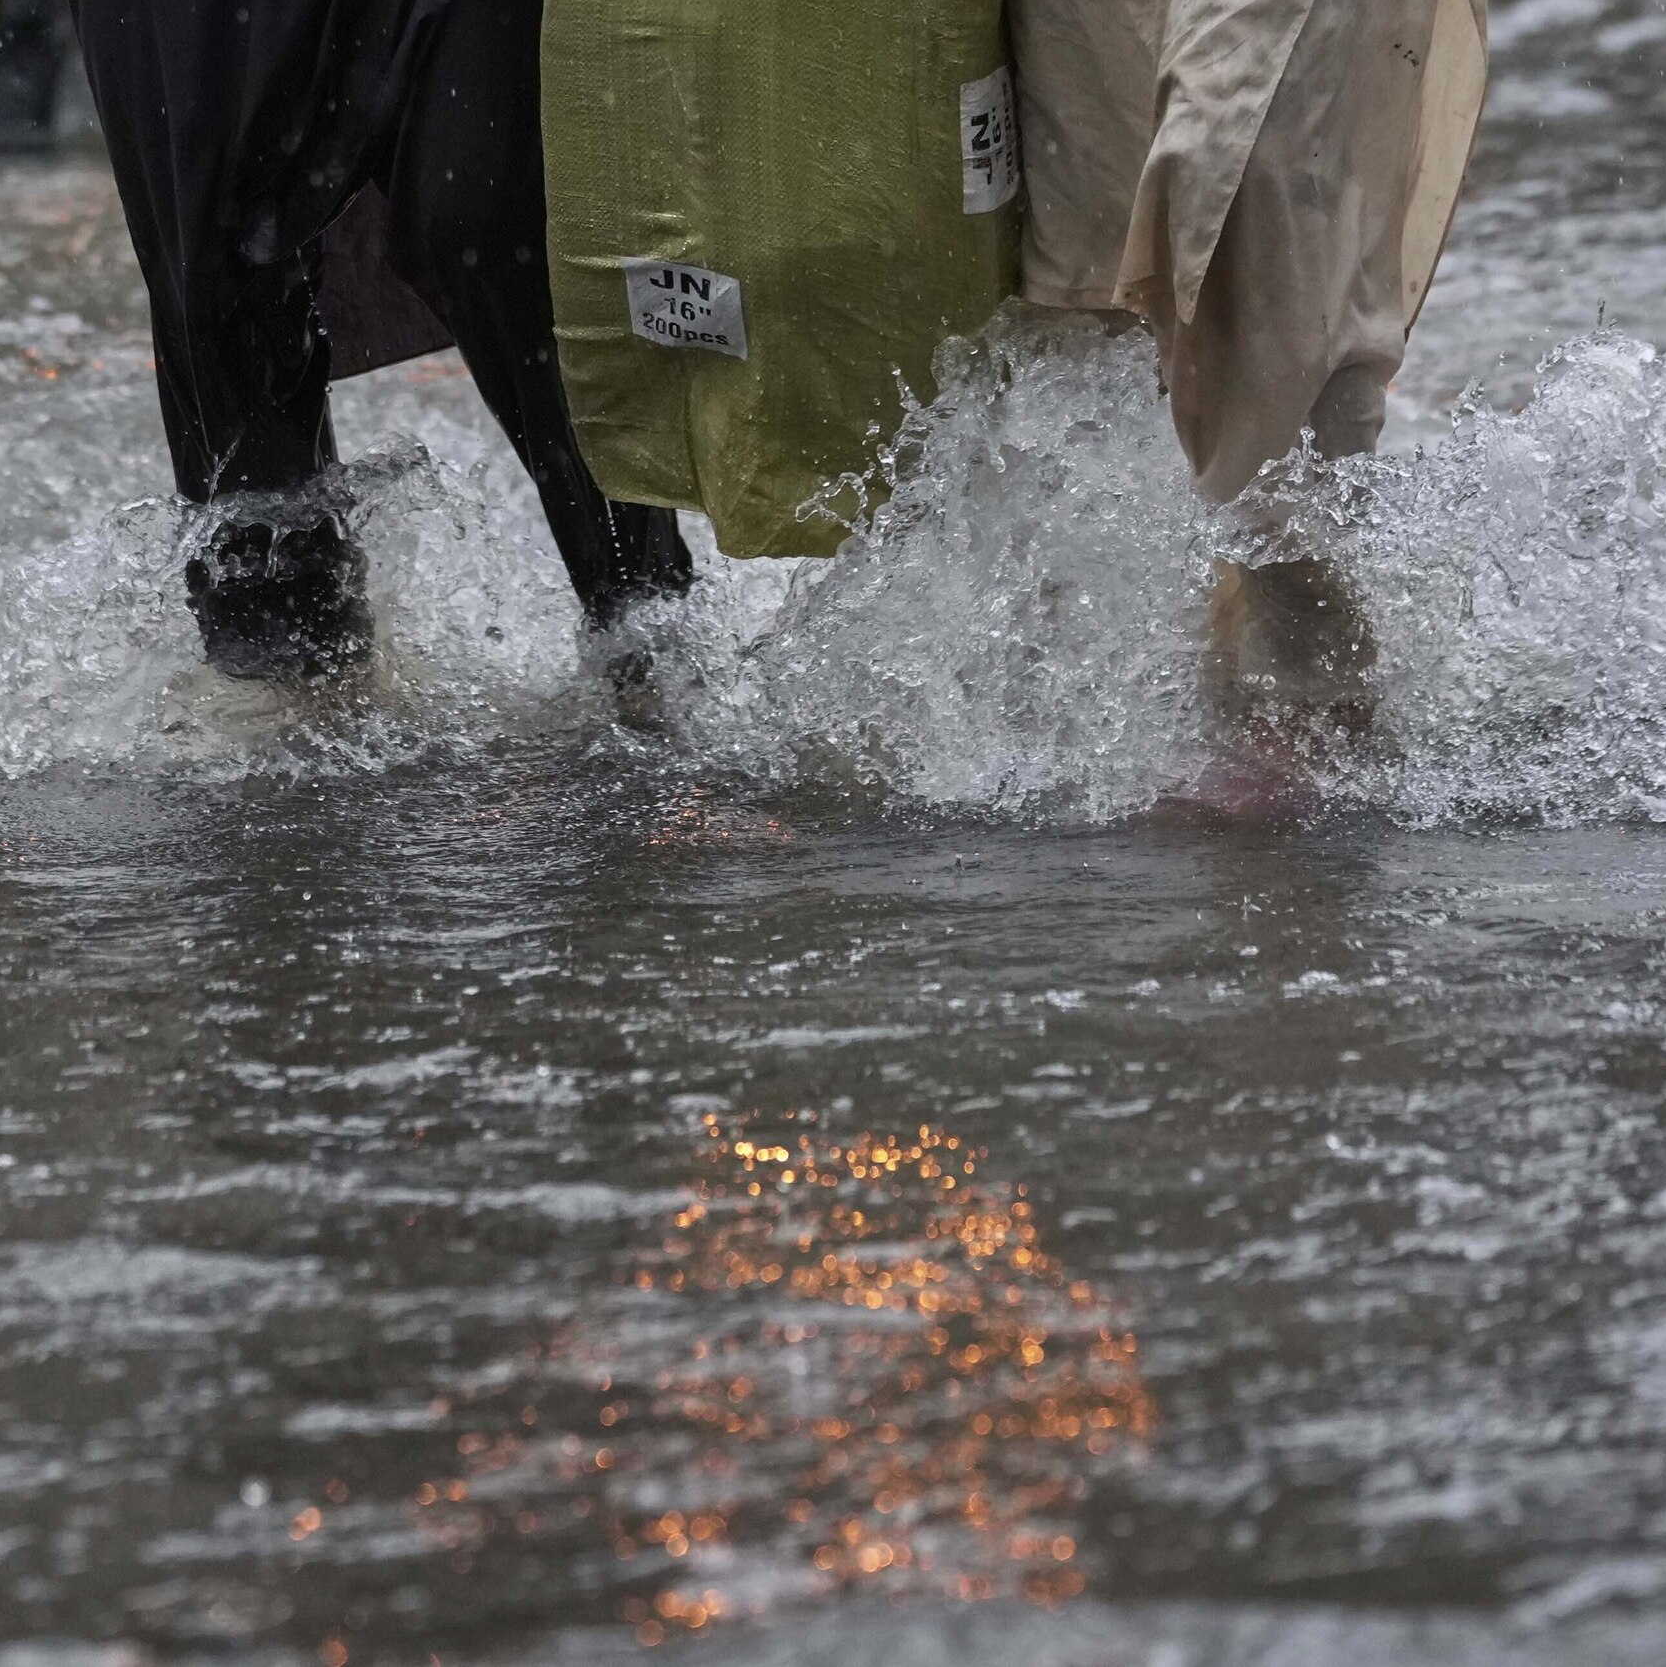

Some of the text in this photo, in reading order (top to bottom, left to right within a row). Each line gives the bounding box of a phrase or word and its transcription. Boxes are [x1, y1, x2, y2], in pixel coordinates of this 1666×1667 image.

[970, 112, 992, 185] JN
[649, 269, 711, 302] JN
[663, 297, 712, 321] 16"
[642, 312, 730, 346] 200pcs
